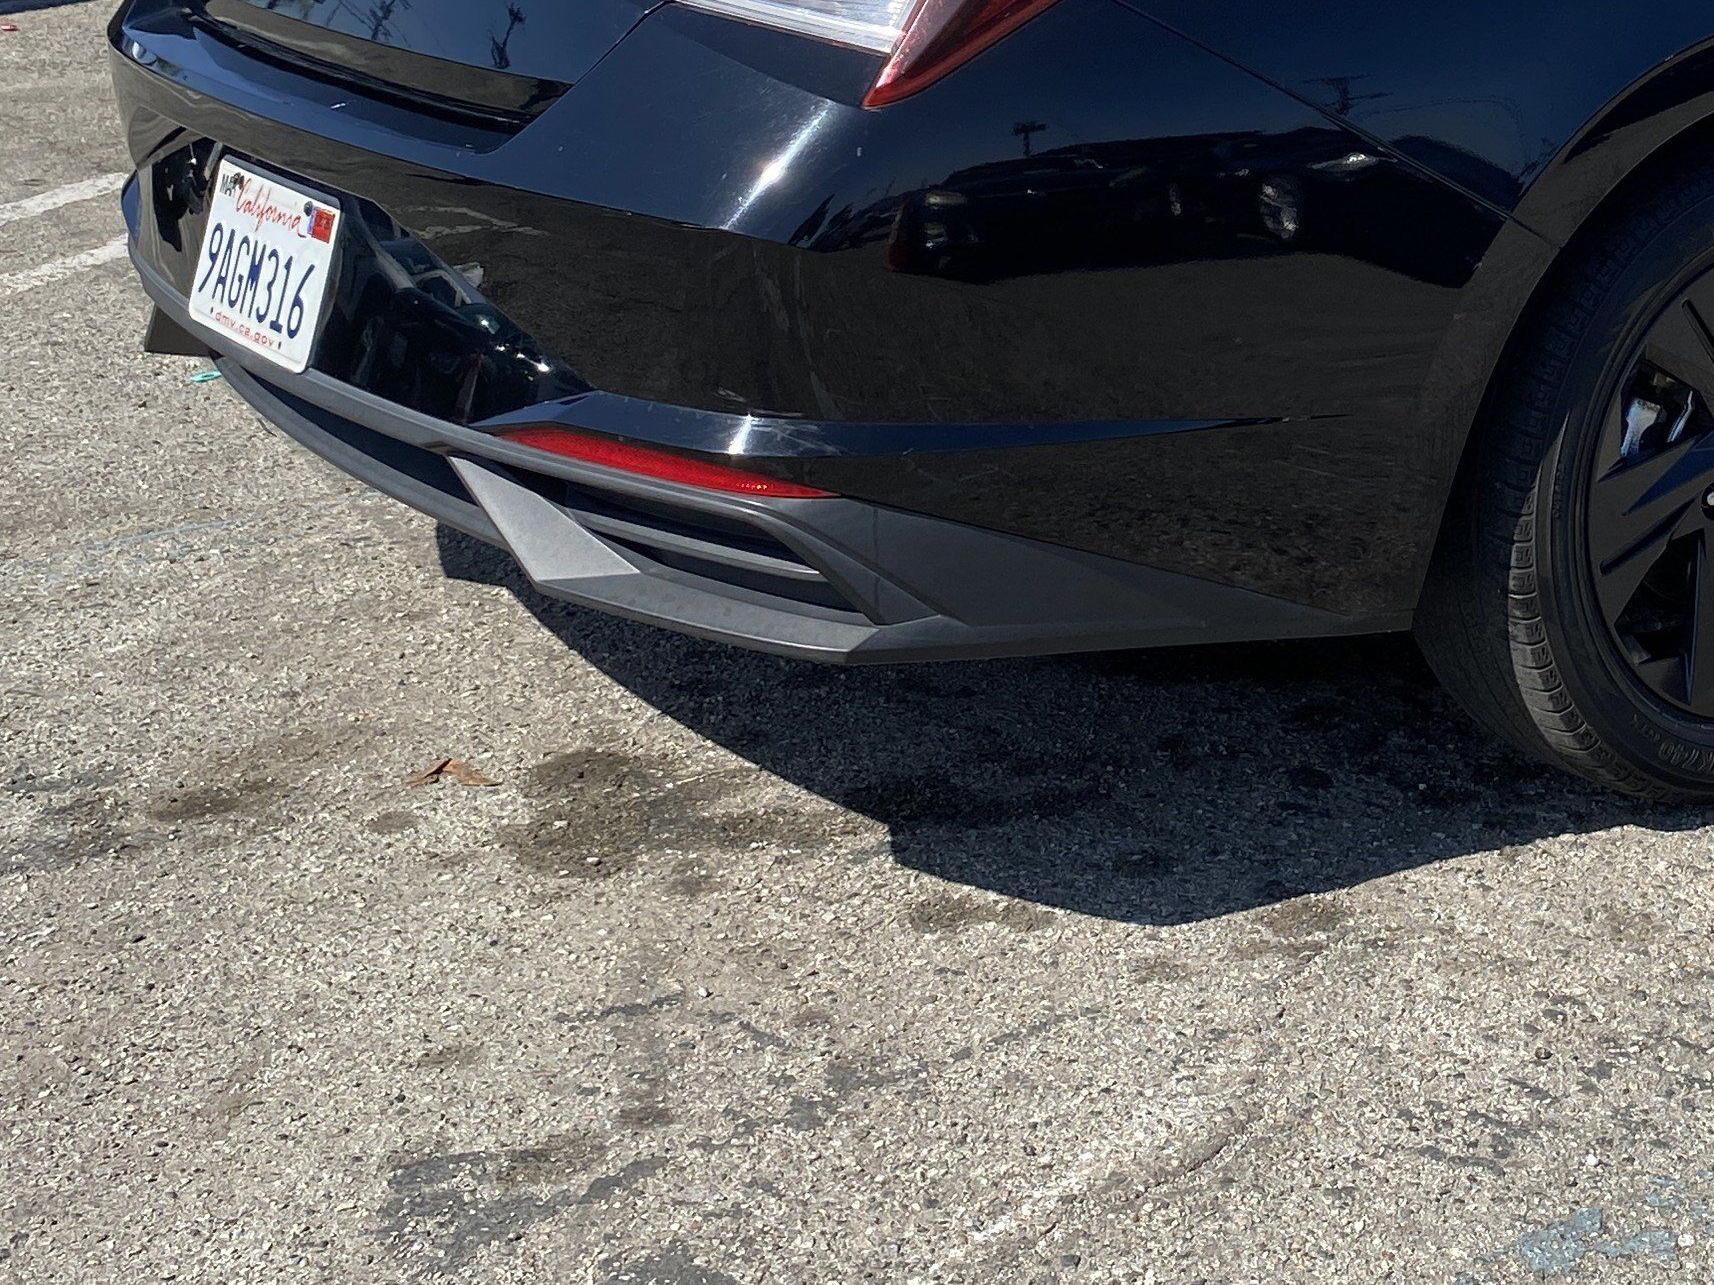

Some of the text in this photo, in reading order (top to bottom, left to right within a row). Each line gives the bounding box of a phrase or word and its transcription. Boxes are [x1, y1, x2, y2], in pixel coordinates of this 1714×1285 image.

[235, 175, 306, 238] California
[198, 222, 315, 339] 9AGM316
[215, 309, 275, 349] dmv.ca.gov
